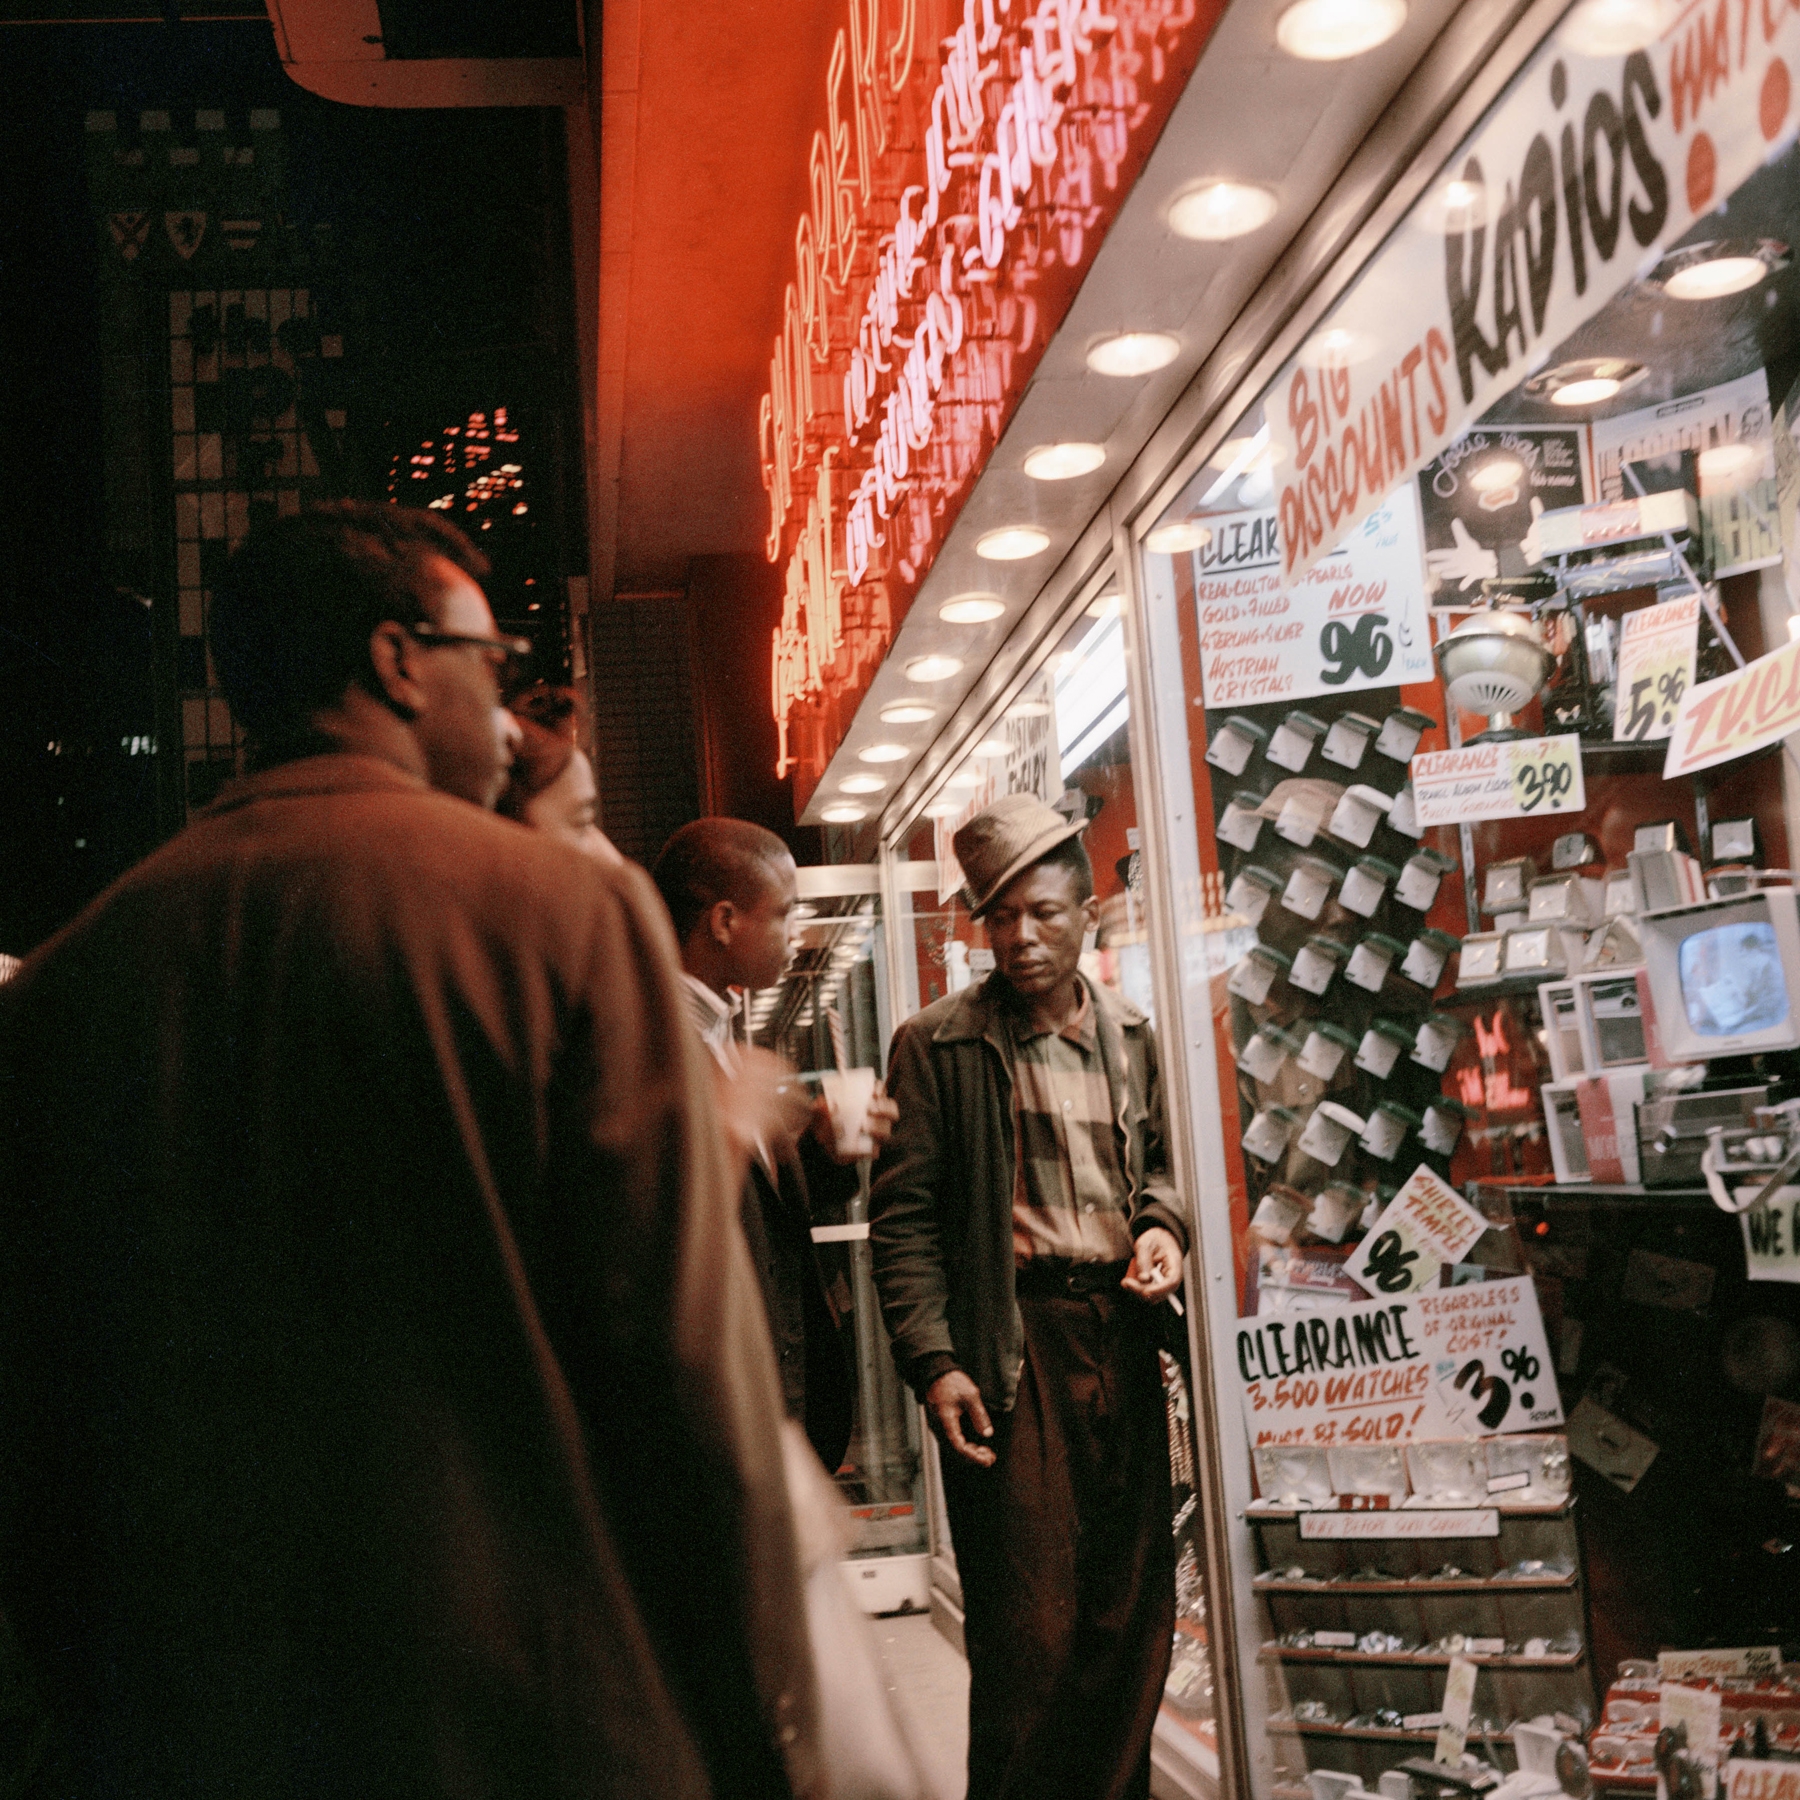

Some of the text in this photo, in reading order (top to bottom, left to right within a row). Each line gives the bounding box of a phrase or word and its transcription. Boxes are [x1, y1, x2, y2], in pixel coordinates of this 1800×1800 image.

[1445, 48, 1668, 405] RADIOS
[1289, 350, 1350, 471] BIG
[1280, 326, 1448, 575] DISCOUNTS
[1328, 580, 1387, 611] NOW
[1624, 597, 1697, 636] CLEARANCE
[1208, 654, 1279, 680] AUSTRIAN
[1415, 745, 1499, 777] CLEARANCE
[1403, 1195, 1467, 1254] TEMPLE
[1414, 1175, 1480, 1237] SHIRLEY
[1418, 1286, 1520, 1315] REGARDLESS
[1237, 1304, 1421, 1382] CLEARANCE
[1424, 1310, 1516, 1337] OF ORIGINAL
[1324, 1363, 1430, 1405] WATCHES
